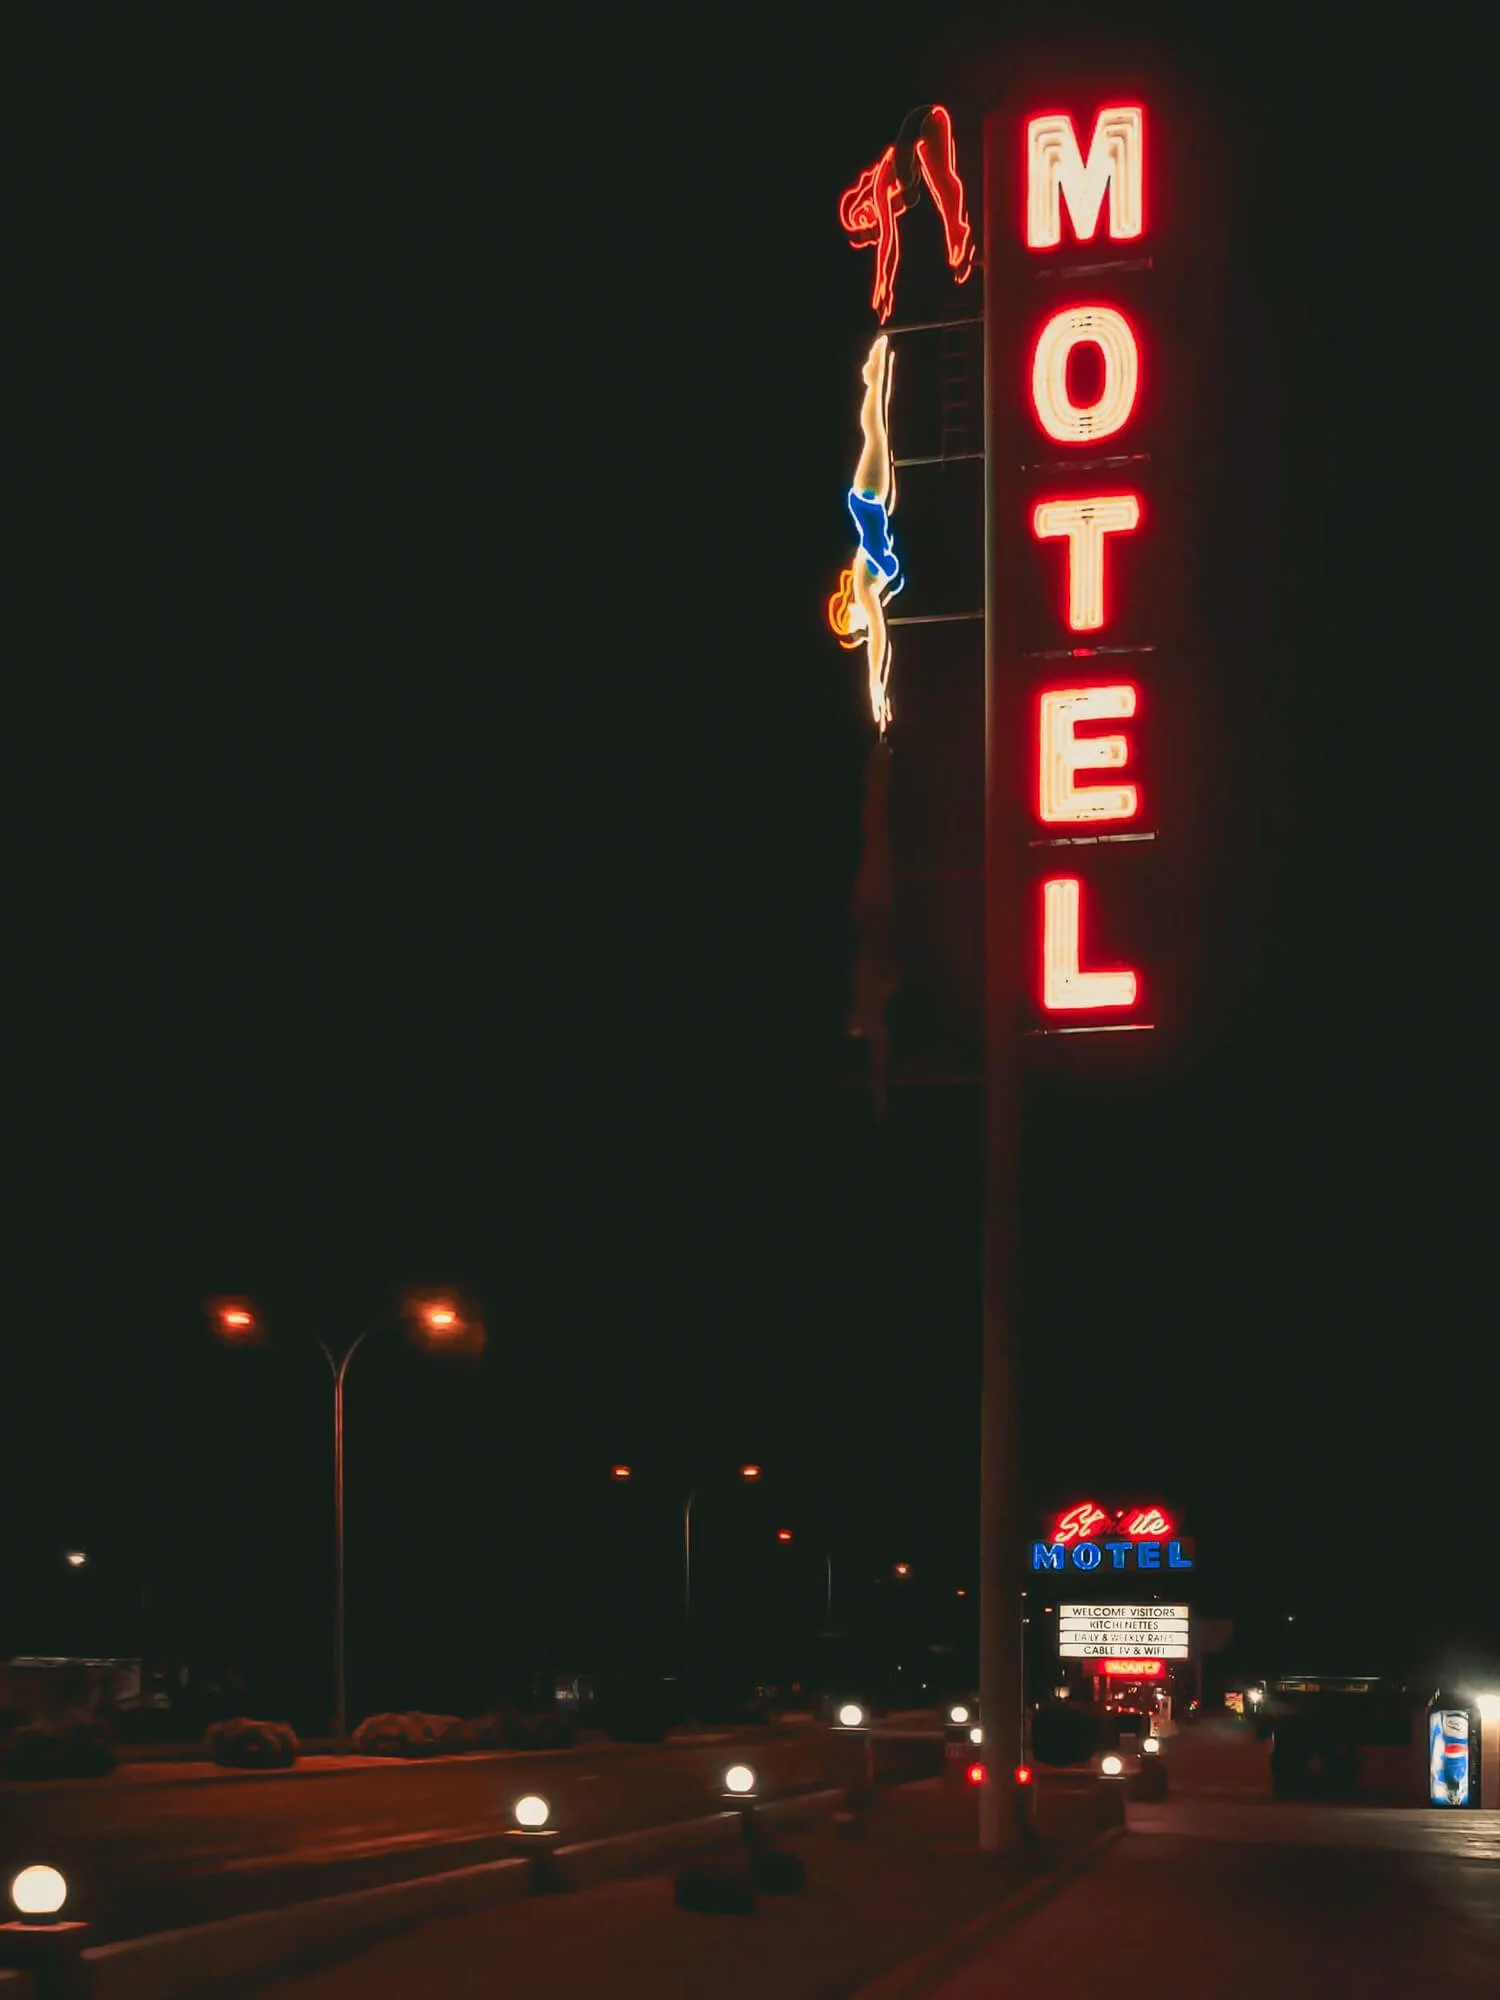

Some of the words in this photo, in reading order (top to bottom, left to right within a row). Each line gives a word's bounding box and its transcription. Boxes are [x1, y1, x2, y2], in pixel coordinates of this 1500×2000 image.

[1025, 105, 1145, 1012] MOTEL
[1032, 1541, 1193, 1570] MOTEL
[1072, 1607, 1126, 1617] WELCOME
[1130, 1607, 1175, 1617] VISITORS
[1089, 1620, 1159, 1630] KITCHENETTES
[1074, 1632, 1099, 1642] DALY
[1101, 1633, 1108, 1642] &
[1110, 1633, 1144, 1643] WEKLY
[1083, 1646, 1114, 1655] CABLE
[1119, 1646, 1130, 1655] TV
[1133, 1646, 1141, 1656] &
[1144, 1646, 1165, 1656] WIFI
